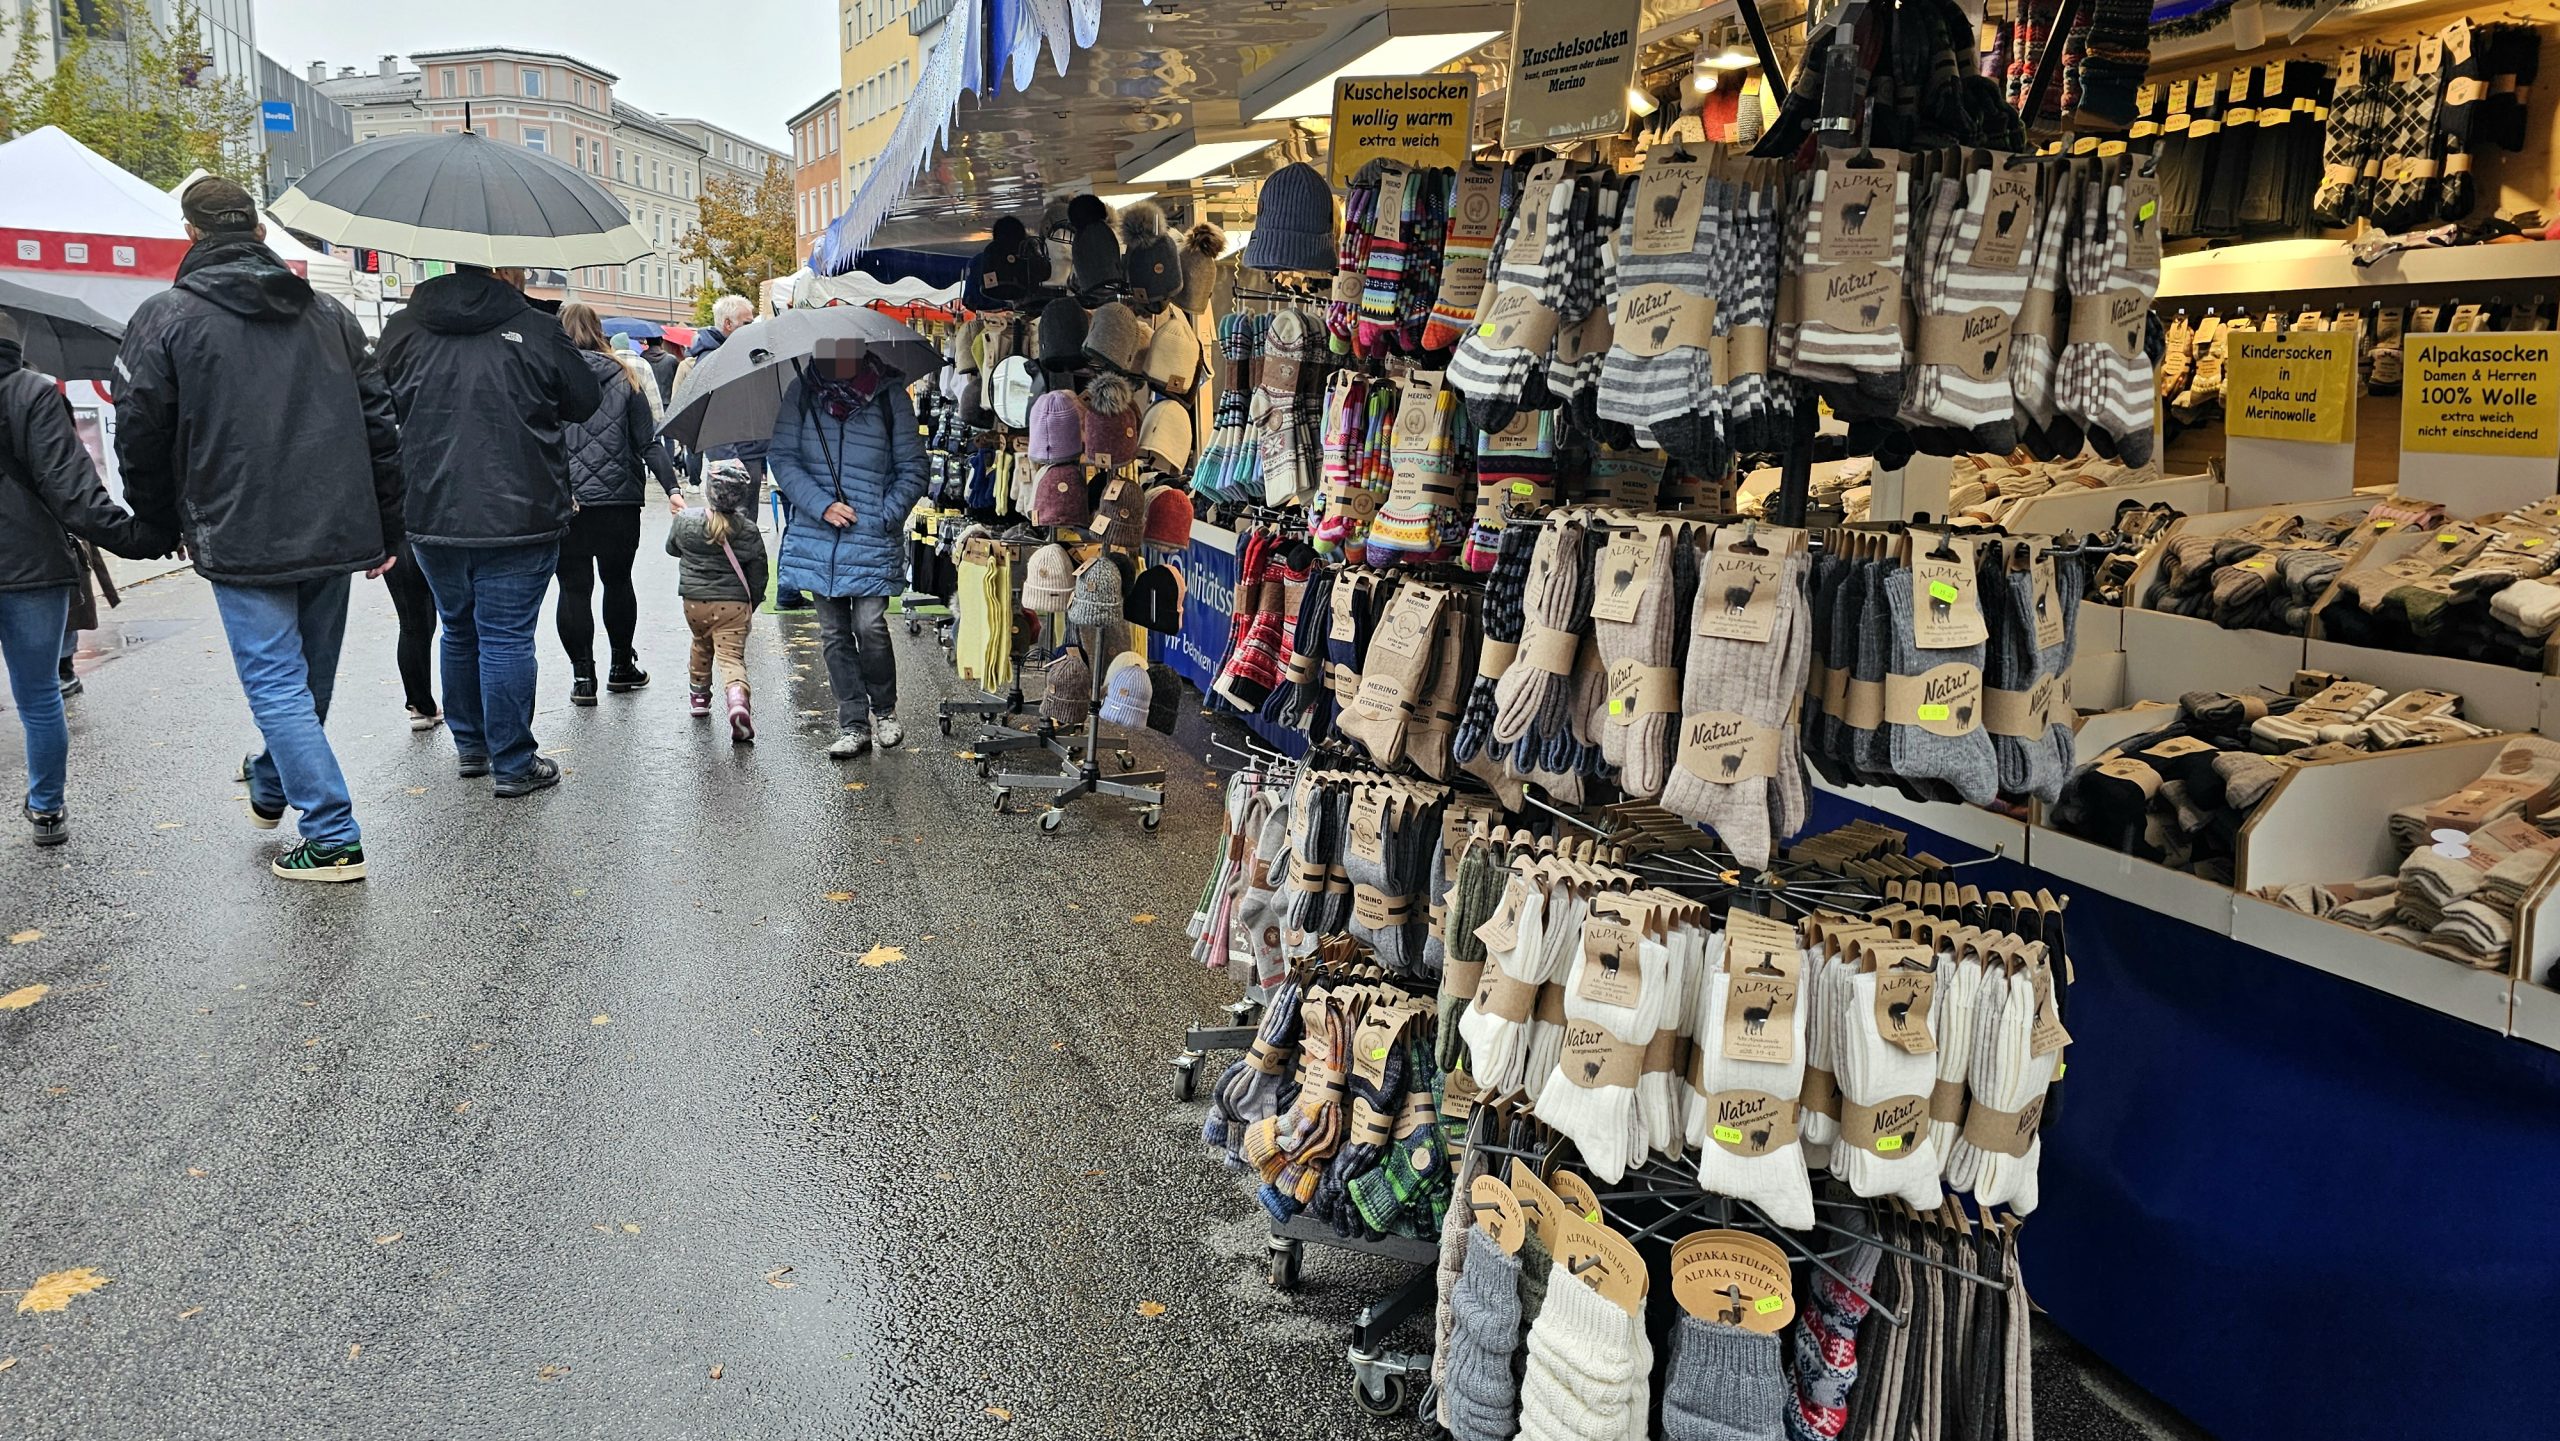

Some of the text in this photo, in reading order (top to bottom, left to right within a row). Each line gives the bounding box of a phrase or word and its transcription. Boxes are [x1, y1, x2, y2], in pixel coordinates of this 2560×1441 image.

[1521, 29, 1629, 68] Kuschelsocken
[1541, 68, 1559, 78] extra
[1560, 64, 1578, 74] warm
[1579, 60, 1595, 70] oder
[1595, 55, 1620, 67] dünner
[1344, 81, 1469, 101] Kuschelsocken
[1548, 75, 1586, 93] Merino
[1352, 109, 1453, 131] wollig warm
[1359, 133, 1440, 147] extra weich
[1645, 169, 1703, 187] ALPAKA
[1832, 175, 1892, 194] ALPAKA
[1992, 182, 2031, 206] ALPAKA
[1826, 270, 1877, 301] Natur
[1626, 290, 1672, 323] Natur
[1636, 304, 1682, 326] Vorgewaschen
[2111, 296, 2141, 324] Natur
[1962, 313, 2000, 342] Natur
[2241, 344, 2332, 361] Kindersocken
[2418, 344, 2549, 367] Alpakasocken
[2279, 367, 2290, 380] in
[2423, 369, 2536, 381] Damen & Herren
[2249, 386, 2316, 404] Alpaka und
[2421, 387, 2537, 405] 100% Wolle
[2245, 406, 2316, 423] Merinowolle
[2441, 411, 2514, 423] extra weich
[2418, 425, 2538, 439] nicht einschneidend
[1622, 481, 1648, 489] MERINO
[1609, 544, 1650, 564] ALPAKA
[1716, 560, 1776, 581] ALPAKA
[1919, 566, 1972, 587] ALPAKA
[1406, 598, 1430, 610] MERINO
[1367, 681, 1398, 695] MERINO
[1610, 663, 1633, 696] Natur
[1924, 670, 1970, 705] Natur
[1360, 699, 1393, 713] EXTRA WEICH
[1690, 720, 1741, 748] Natur
[1702, 735, 1754, 752] Vorgewaschen
[1357, 804, 1377, 815] MERINO
[1357, 892, 1383, 905] MERINO
[1589, 928, 1635, 949] ALPAKA
[1734, 982, 1792, 1001] ALPAKA
[1881, 978, 1930, 995] ALPAKA
[1565, 1027, 1603, 1048] Natur
[1572, 1047, 1612, 1055] Vorgewaschen
[1718, 1097, 1765, 1124] Natur
[1730, 1109, 1778, 1128] Vorgewaschen
[1873, 1099, 1915, 1134] Natur
[1516, 1179, 1535, 1194] ALPAKA
[1554, 1176, 1576, 1190] ALPAKA
[1477, 1182, 1522, 1228] ALPAKA STULPEN
[1566, 1233, 1632, 1285] ALPAKA STULPEN
[1682, 1250, 1783, 1282] ALPAKA STULPEN
[1685, 1268, 1788, 1302] ALPAKA STULPEN
